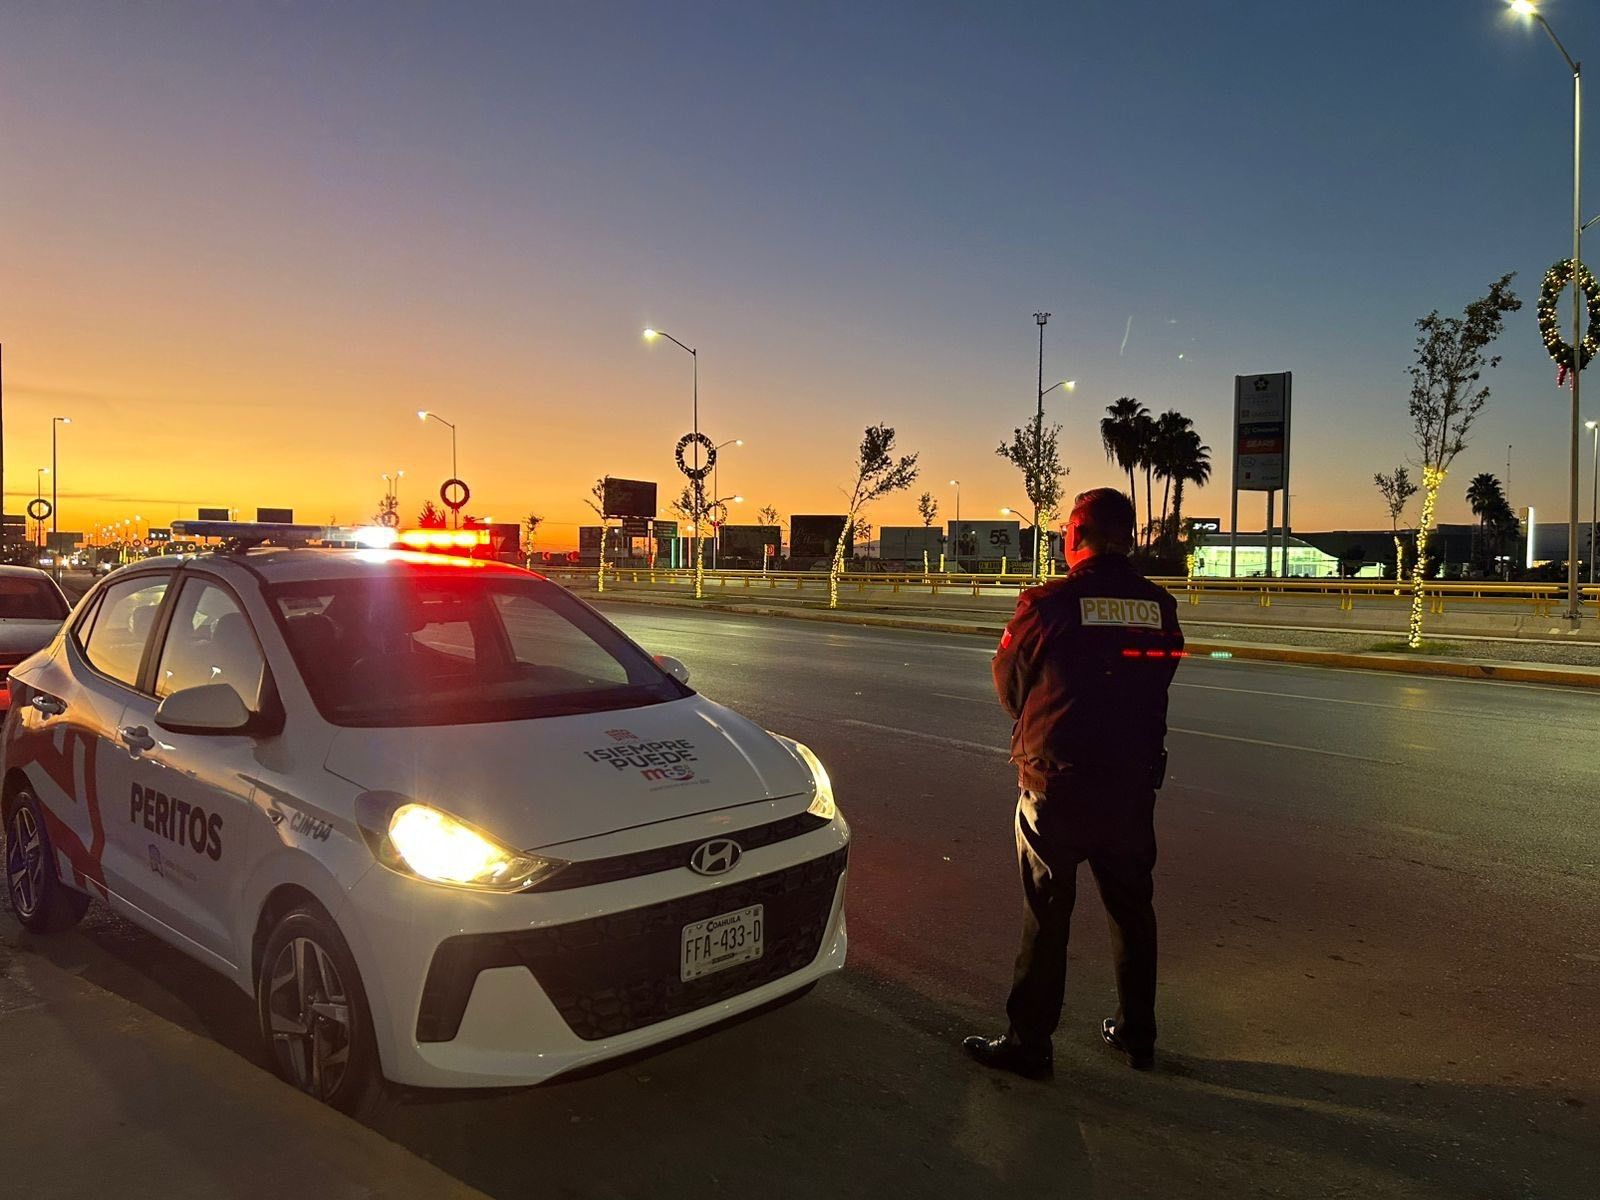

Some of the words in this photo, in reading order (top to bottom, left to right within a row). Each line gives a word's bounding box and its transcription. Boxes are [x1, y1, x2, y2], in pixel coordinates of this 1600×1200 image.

[1083, 599, 1159, 623] PERITOS
[609, 750, 698, 771] PUEDE
[130, 782, 223, 861] PERITOS
[706, 915, 741, 932] COAHUILA
[685, 920, 761, 964] FFA-433-D
